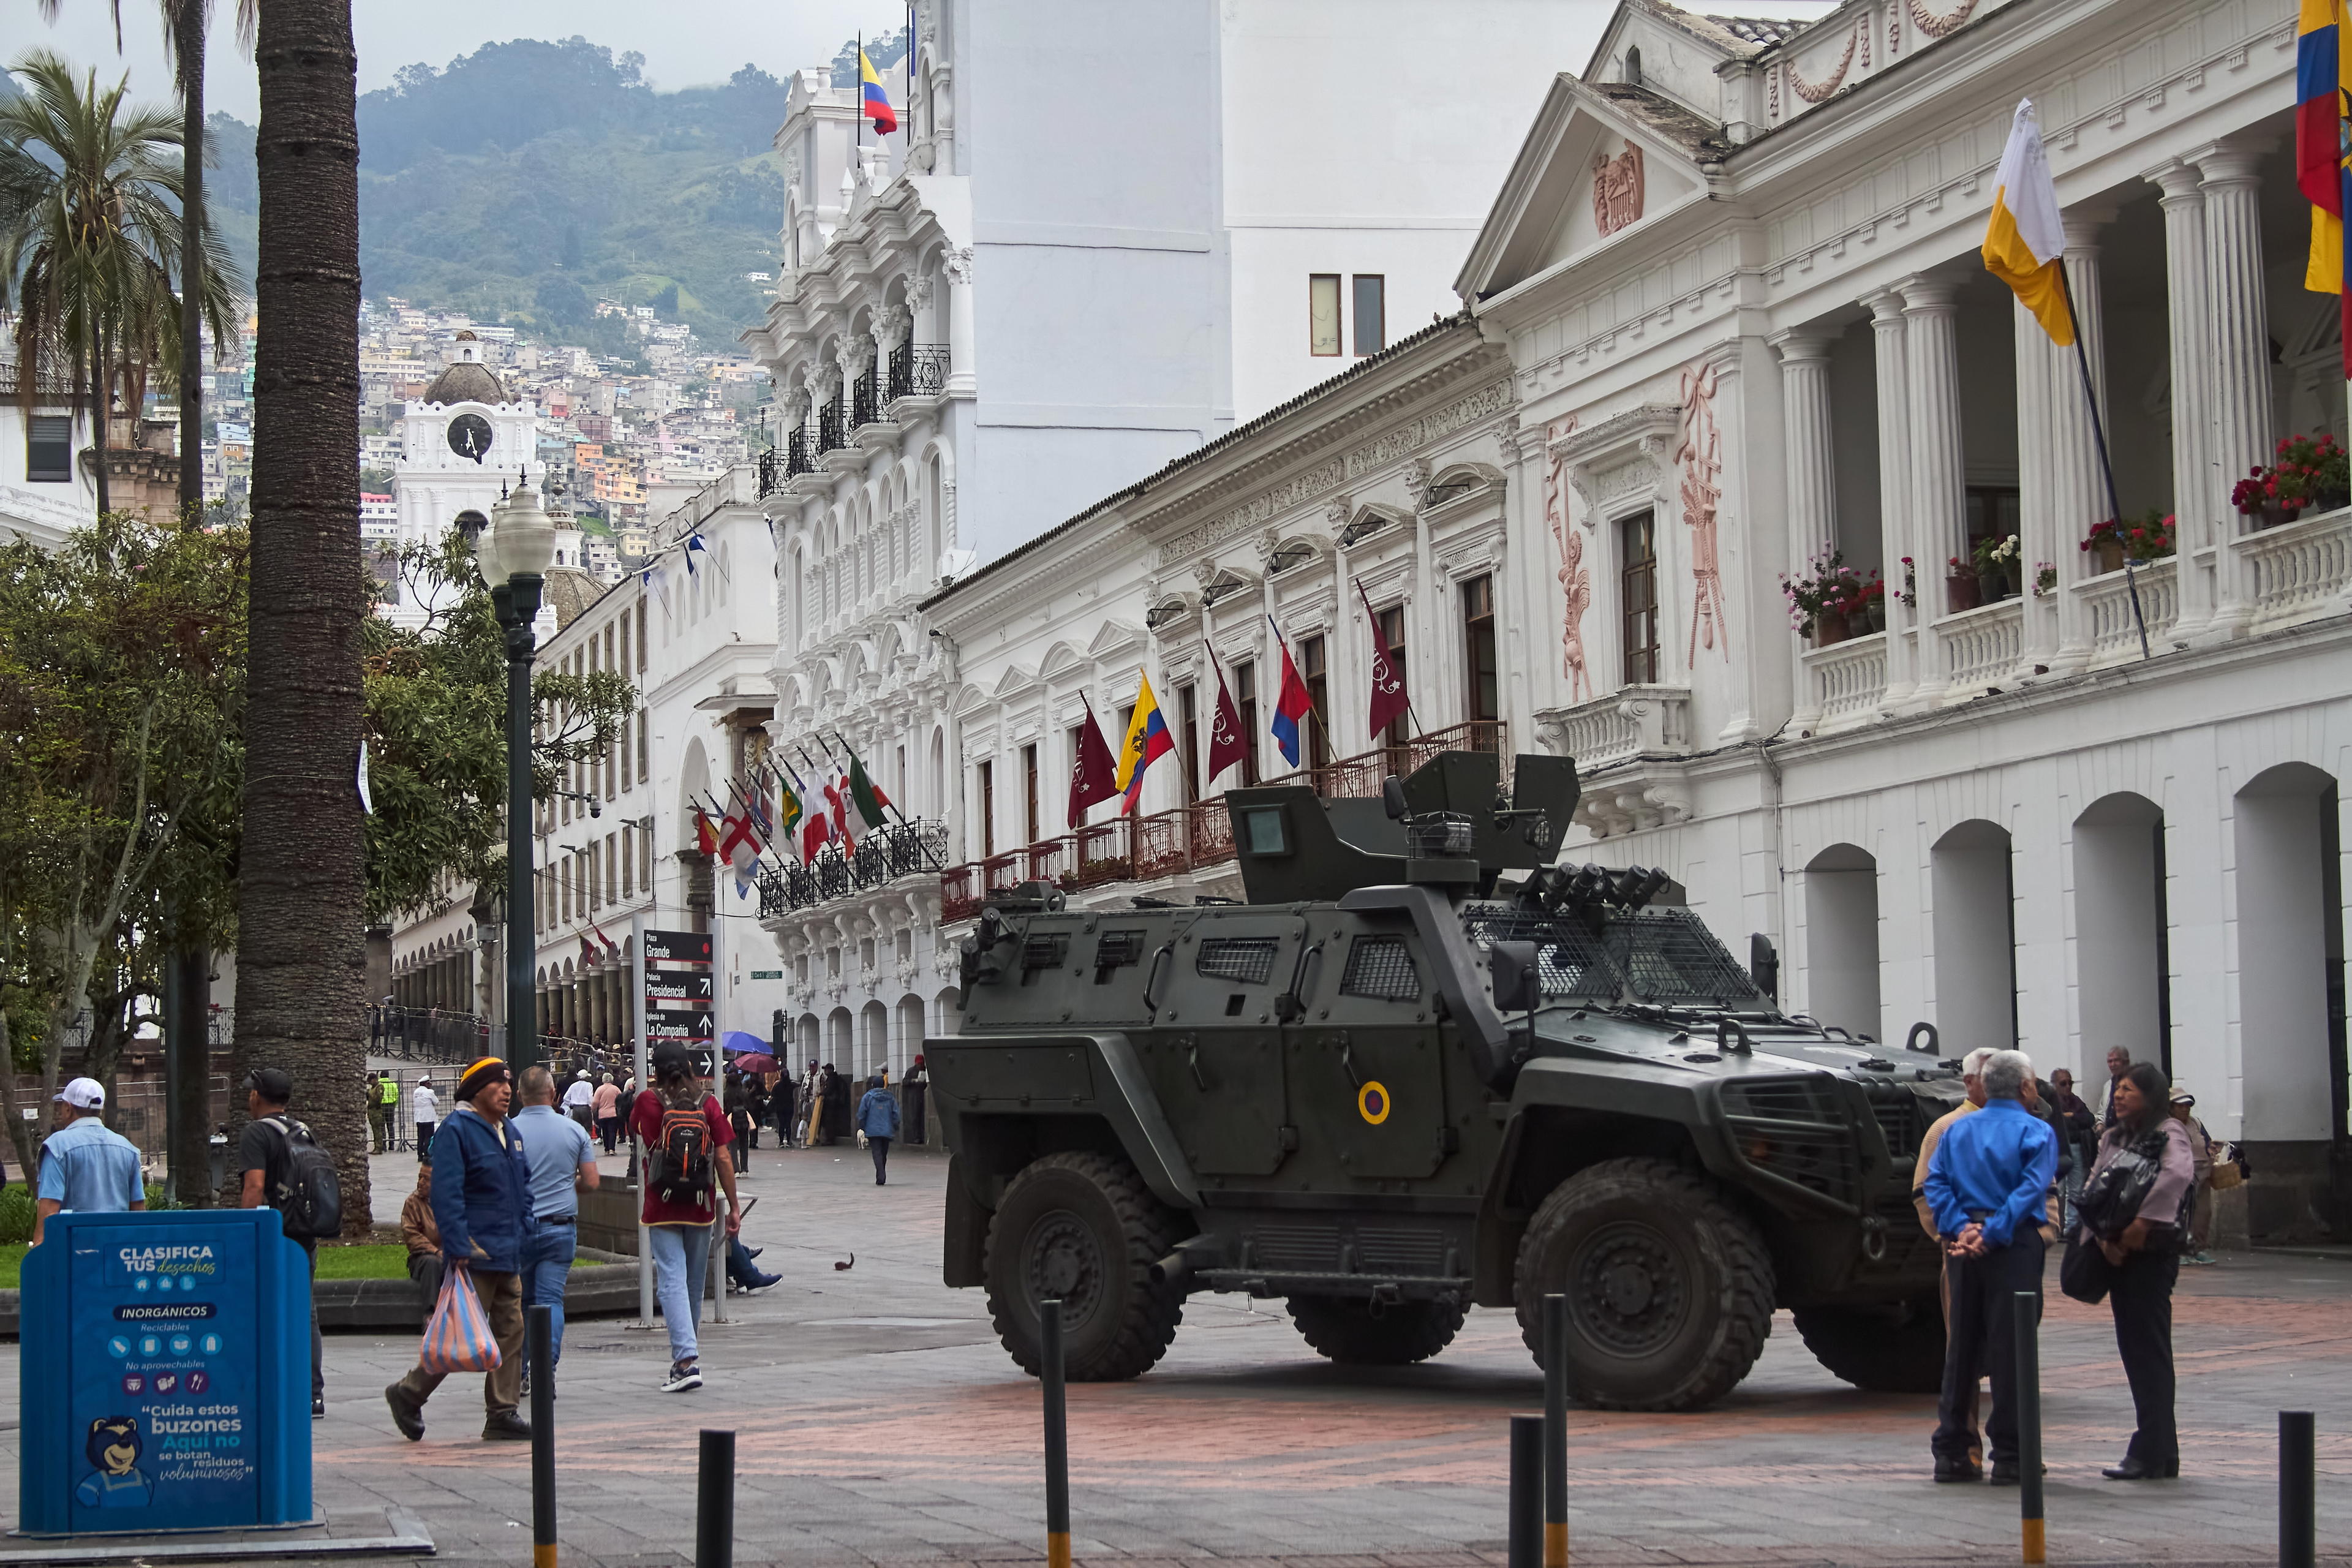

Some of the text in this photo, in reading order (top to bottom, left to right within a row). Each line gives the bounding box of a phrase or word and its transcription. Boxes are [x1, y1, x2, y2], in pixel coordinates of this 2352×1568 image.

[646, 944, 670, 958] Grande
[647, 984, 686, 998] Presidencial
[646, 1012, 660, 1021] Iglesia
[647, 1023, 688, 1039] La Compañía
[119, 1246, 213, 1260] CLASIFICA
[124, 1257, 216, 1276] TUS desechos
[123, 1305, 207, 1318] INORGÁNICOS
[141, 1322, 190, 1332] Reciclables
[126, 1360, 205, 1371] No aprovechables
[198, 1404, 238, 1415] estos
[151, 1417, 242, 1434] buzones
[162, 1433, 241, 1451] Aquí no
[159, 1451, 211, 1461] se botan
[193, 1457, 244, 1468] residuos
